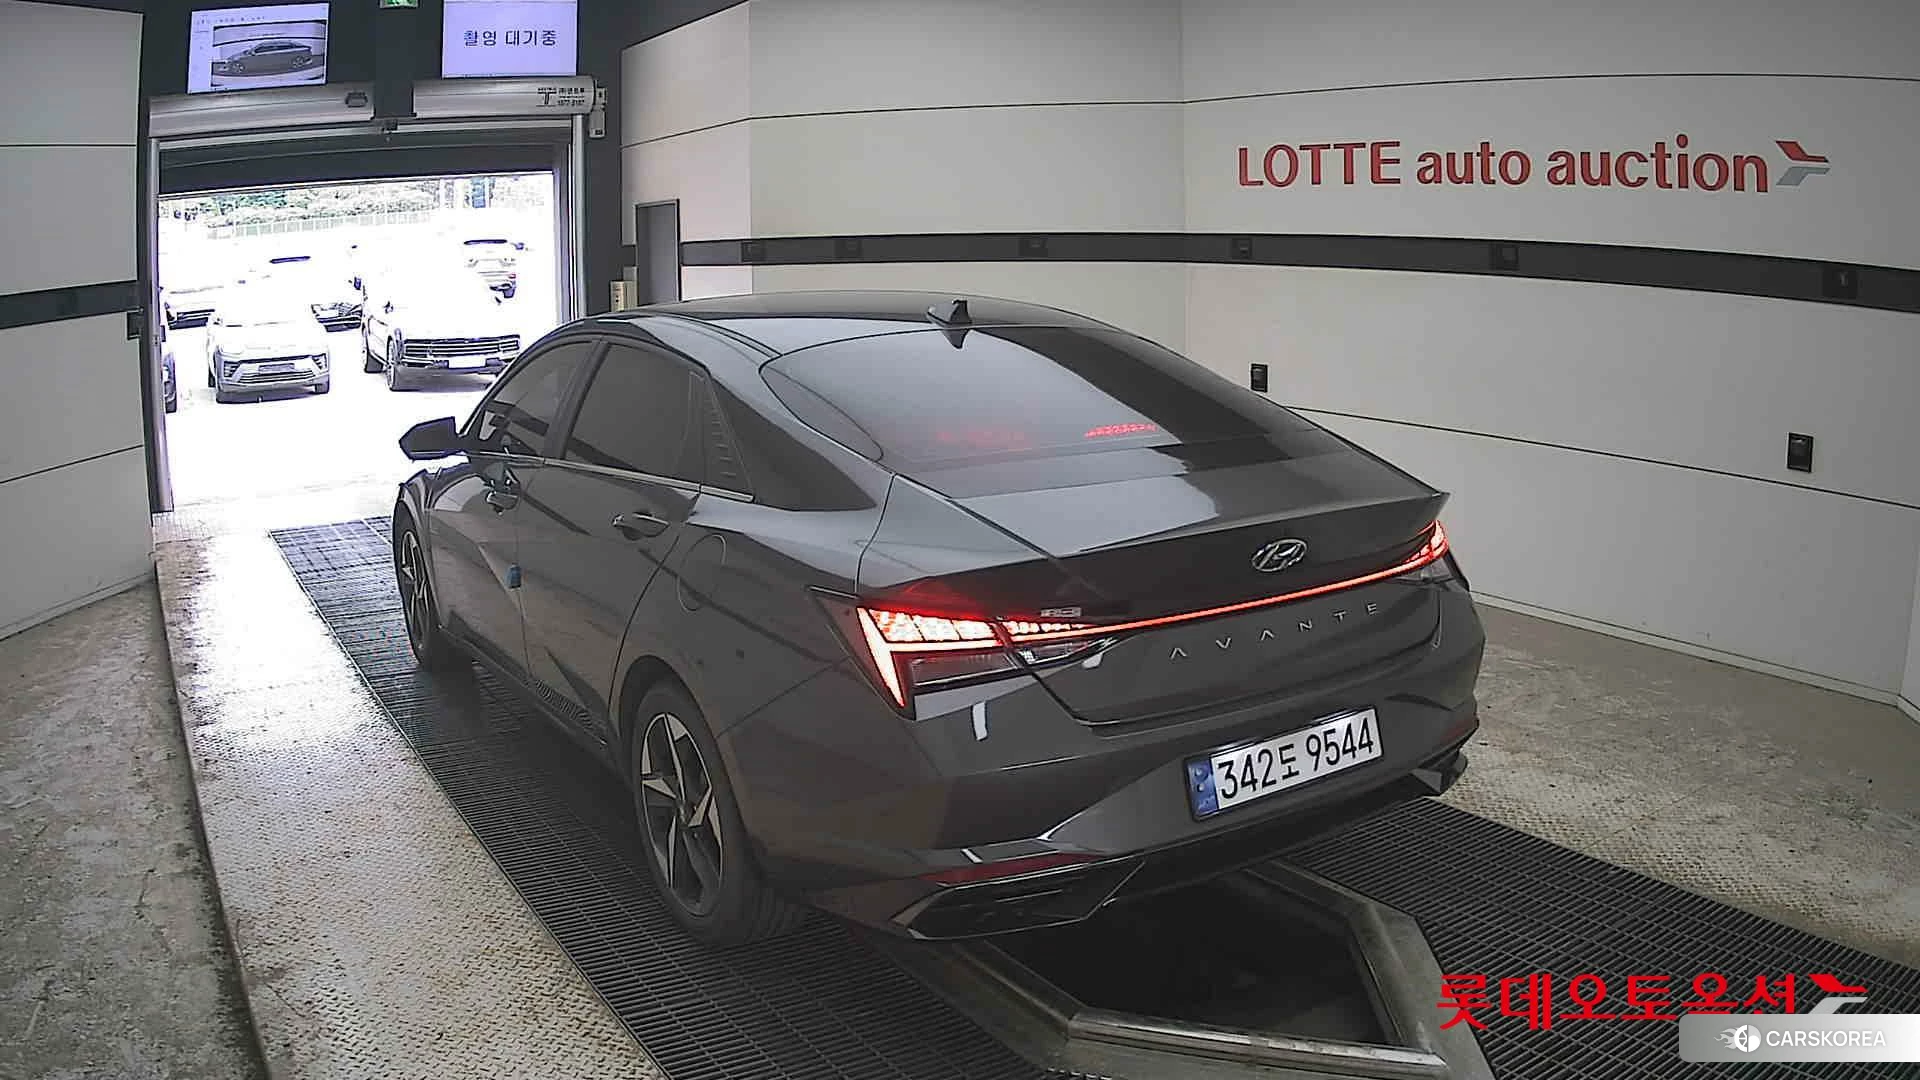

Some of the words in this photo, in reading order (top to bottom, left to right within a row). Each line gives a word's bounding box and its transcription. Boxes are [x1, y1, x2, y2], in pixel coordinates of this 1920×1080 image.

[505, 30, 557, 47] 대기중
[1238, 141, 1401, 187] LOTTE
[1416, 142, 1532, 185] auto
[1547, 134, 1768, 192] auction
[1169, 603, 1378, 660] AVANTE
